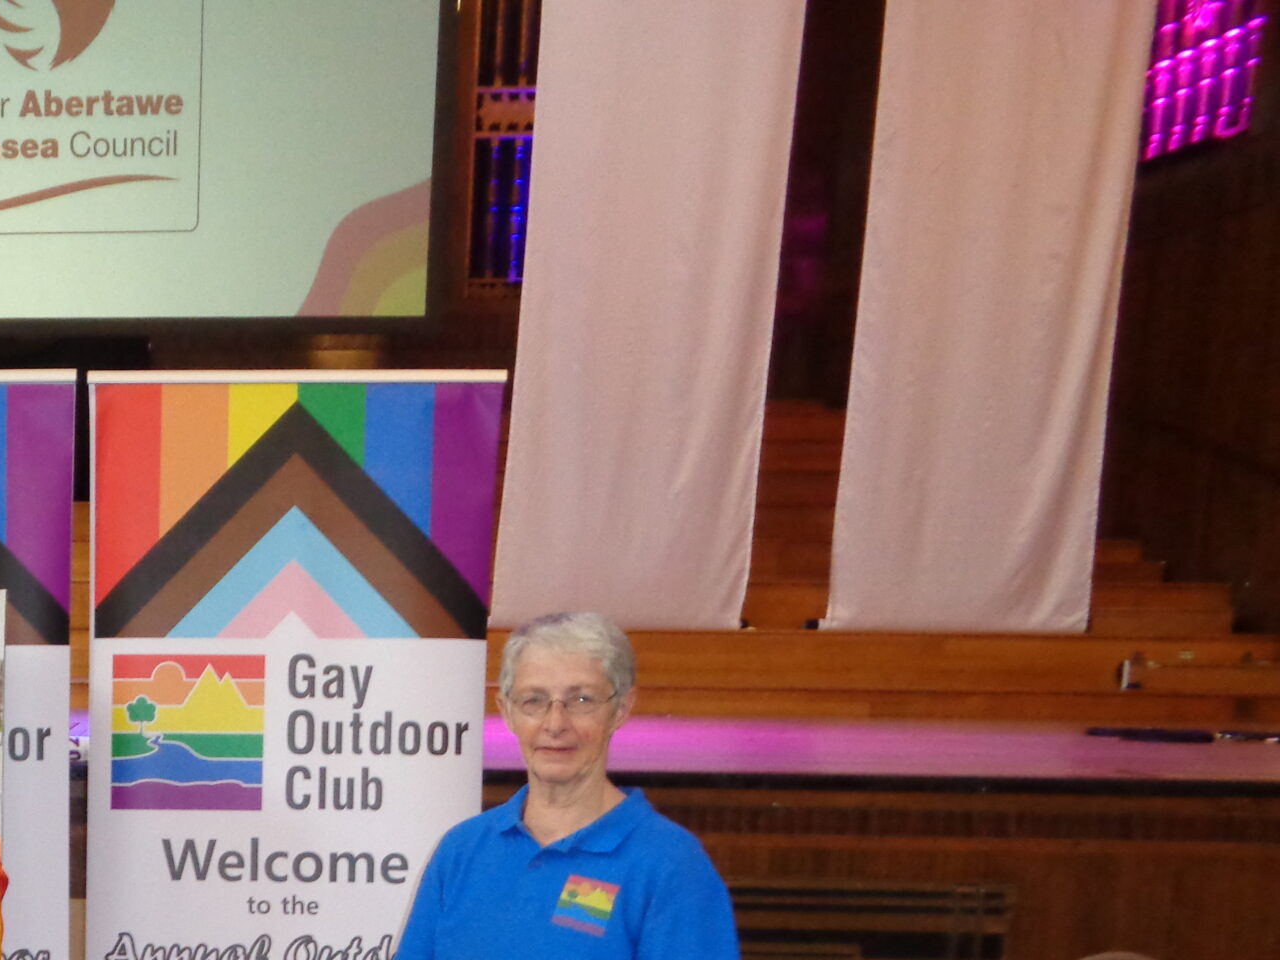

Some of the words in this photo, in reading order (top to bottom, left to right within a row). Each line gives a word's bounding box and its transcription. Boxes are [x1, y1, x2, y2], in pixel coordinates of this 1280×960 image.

[19, 89, 184, 118] Abertawe
[69, 129, 178, 159] Council
[287, 653, 373, 710] Gay
[286, 709, 470, 757] Outdoor
[284, 765, 384, 811] Club
[161, 836, 409, 885] Welcome
[246, 896, 271, 915] to
[281, 894, 320, 915] the
